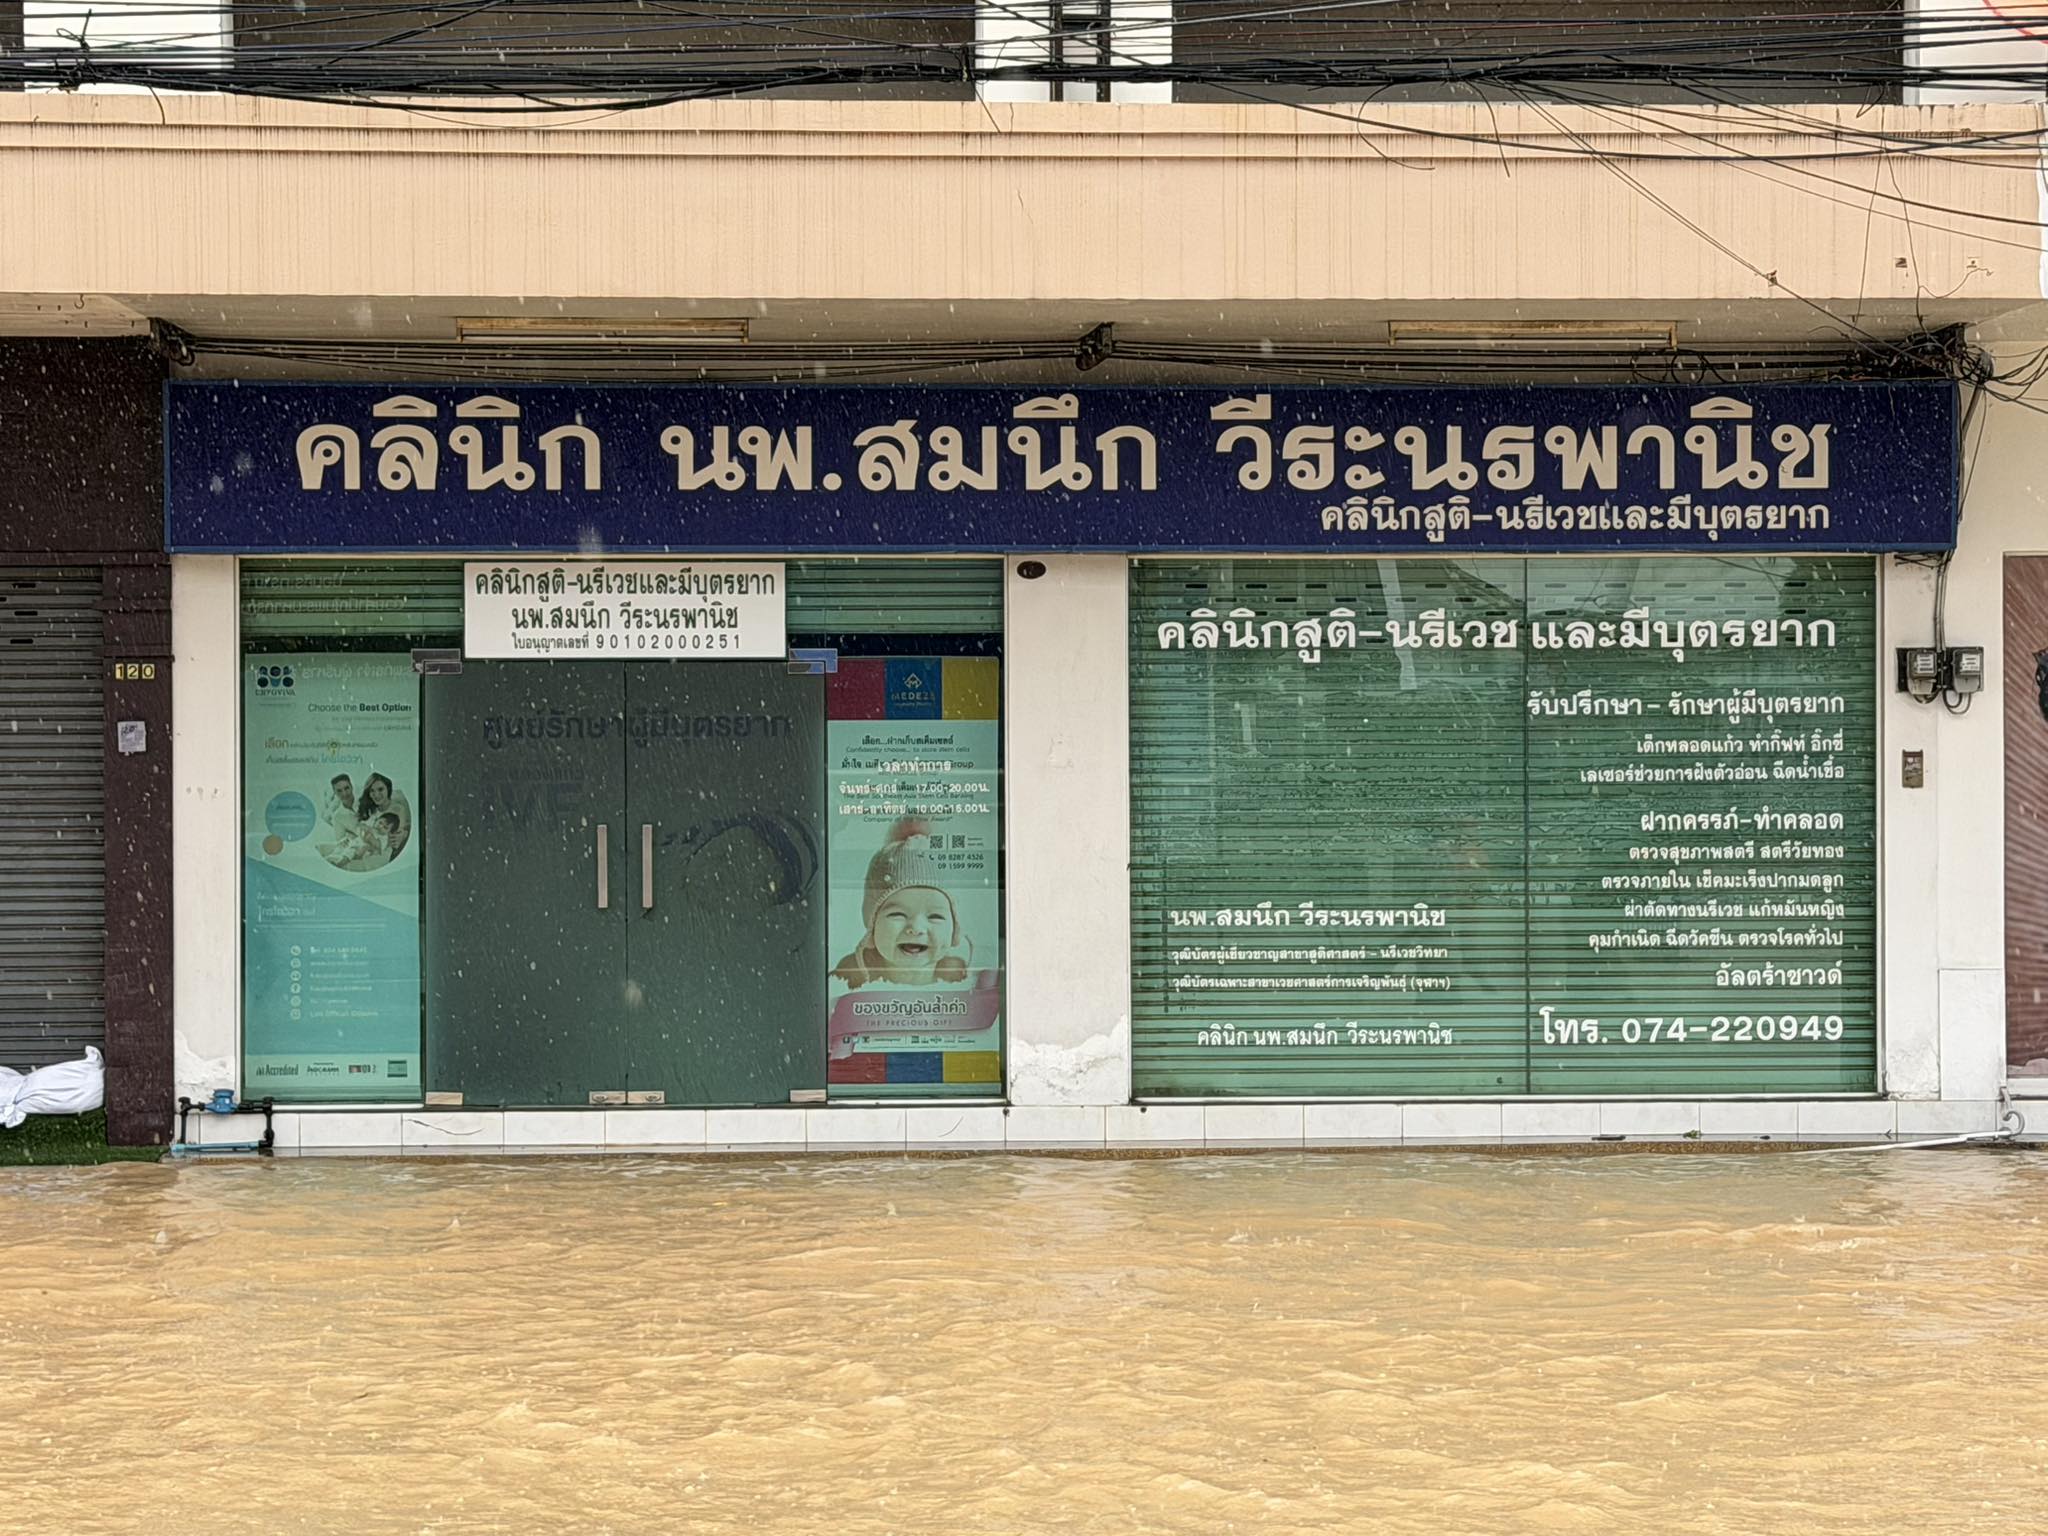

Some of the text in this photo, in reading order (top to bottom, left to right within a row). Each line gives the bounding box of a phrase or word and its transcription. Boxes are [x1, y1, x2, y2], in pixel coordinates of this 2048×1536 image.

[297, 394, 1830, 490] คลินิก นพ.สมนึก วีระนรพานิช
[1322, 495, 1828, 541] คลินิกสูติ-นรีเวชและมีบุตรยาก
[476, 567, 774, 602] คลินิกสูติ-นรีเวชและมีบุตรยาก
[512, 602, 737, 628] นพ.สมนึก วีระนรพานิช
[512, 633, 740, 653] ใบอนุญาตเลขที่ 90102000251
[1158, 607, 1834, 662] คลินิกสูติ-นรีเวช และมีบุตรยาก
[116, 664, 155, 679] 120
[308, 702, 412, 714] Choose the Best Option
[1528, 690, 1641, 714] รับปรึกษา
[1669, 688, 1844, 723] รักษาผู้มีบุตรยาก
[1638, 734, 1743, 752] เด็กหลอดแก้ว
[877, 757, 952, 772] เวลาทำการ
[1581, 755, 1843, 782] เลเซอร์ช่วยการฝังตัวอ่อน ฉีดน้ำเชื้อ
[1641, 806, 1843, 830] ฝากครรภ์-ทำคลอด
[1630, 840, 1843, 865] ตรวจสุขภาพสตรี สตรีวัยทอง
[1602, 869, 1843, 893] ตรวจภายใน เช็คมะเร็งปากมดลูก
[1171, 901, 1445, 926] นพ.สมนึก วีระนรพานิช
[1625, 899, 1844, 919] ผ่าตัดทางนรีเวช แก้หมันหญิง
[1589, 924, 1843, 953] คุมกำเนิด ฉีดวัคซีน ตรวจโรคทั่วไป
[1380, 945, 1447, 958] นรีเวชวิทยา
[1716, 961, 1842, 985] อัลตร้าซาวด์
[853, 996, 967, 1017] ของขวัญอันล้ำค่า
[886, 1019, 929, 1027] PRECIOUS
[1198, 1021, 1452, 1045] คลินิก นพ.สมนึก วีระนรพานิช
[1539, 1006, 1843, 1043] โทร. 074-220949
